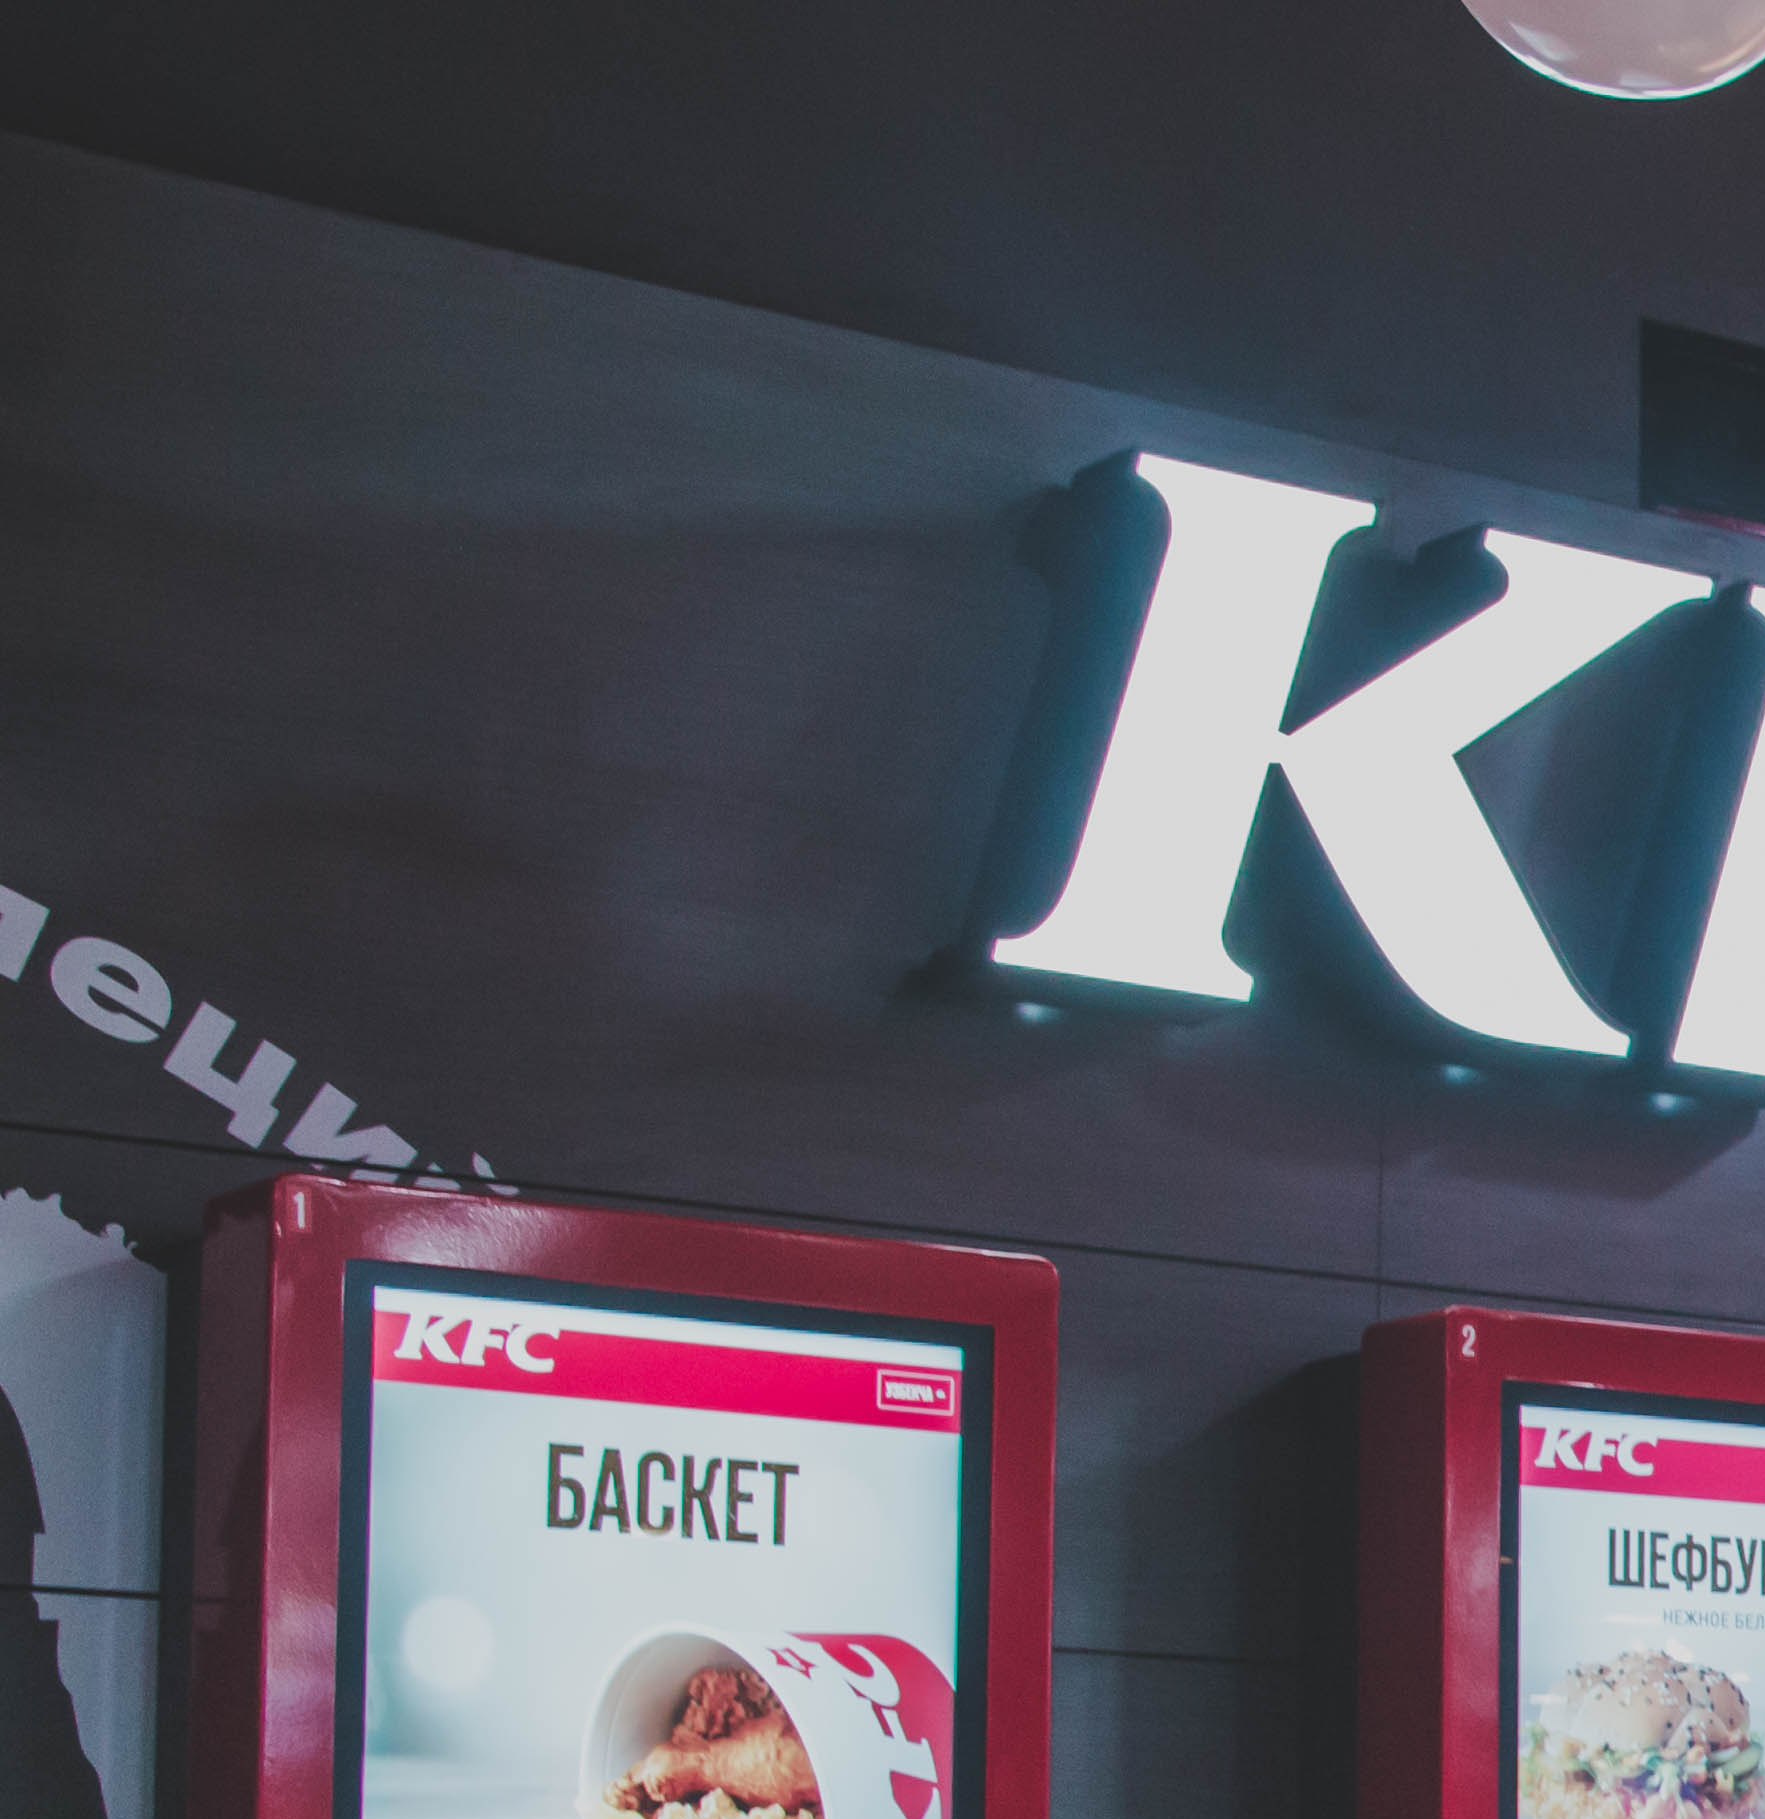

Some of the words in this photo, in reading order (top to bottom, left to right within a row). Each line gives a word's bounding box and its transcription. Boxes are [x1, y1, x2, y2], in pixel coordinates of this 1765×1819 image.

[0, 884, 520, 1197] еци
[293, 1191, 307, 1232] 1
[394, 1311, 561, 1374] KFC
[1461, 1324, 1476, 1357] 2
[1534, 1425, 1659, 1477] KFC
[547, 1442, 800, 1546] БАСКЕТ
[1662, 1607, 1729, 1629] НЕЖНОЕ
